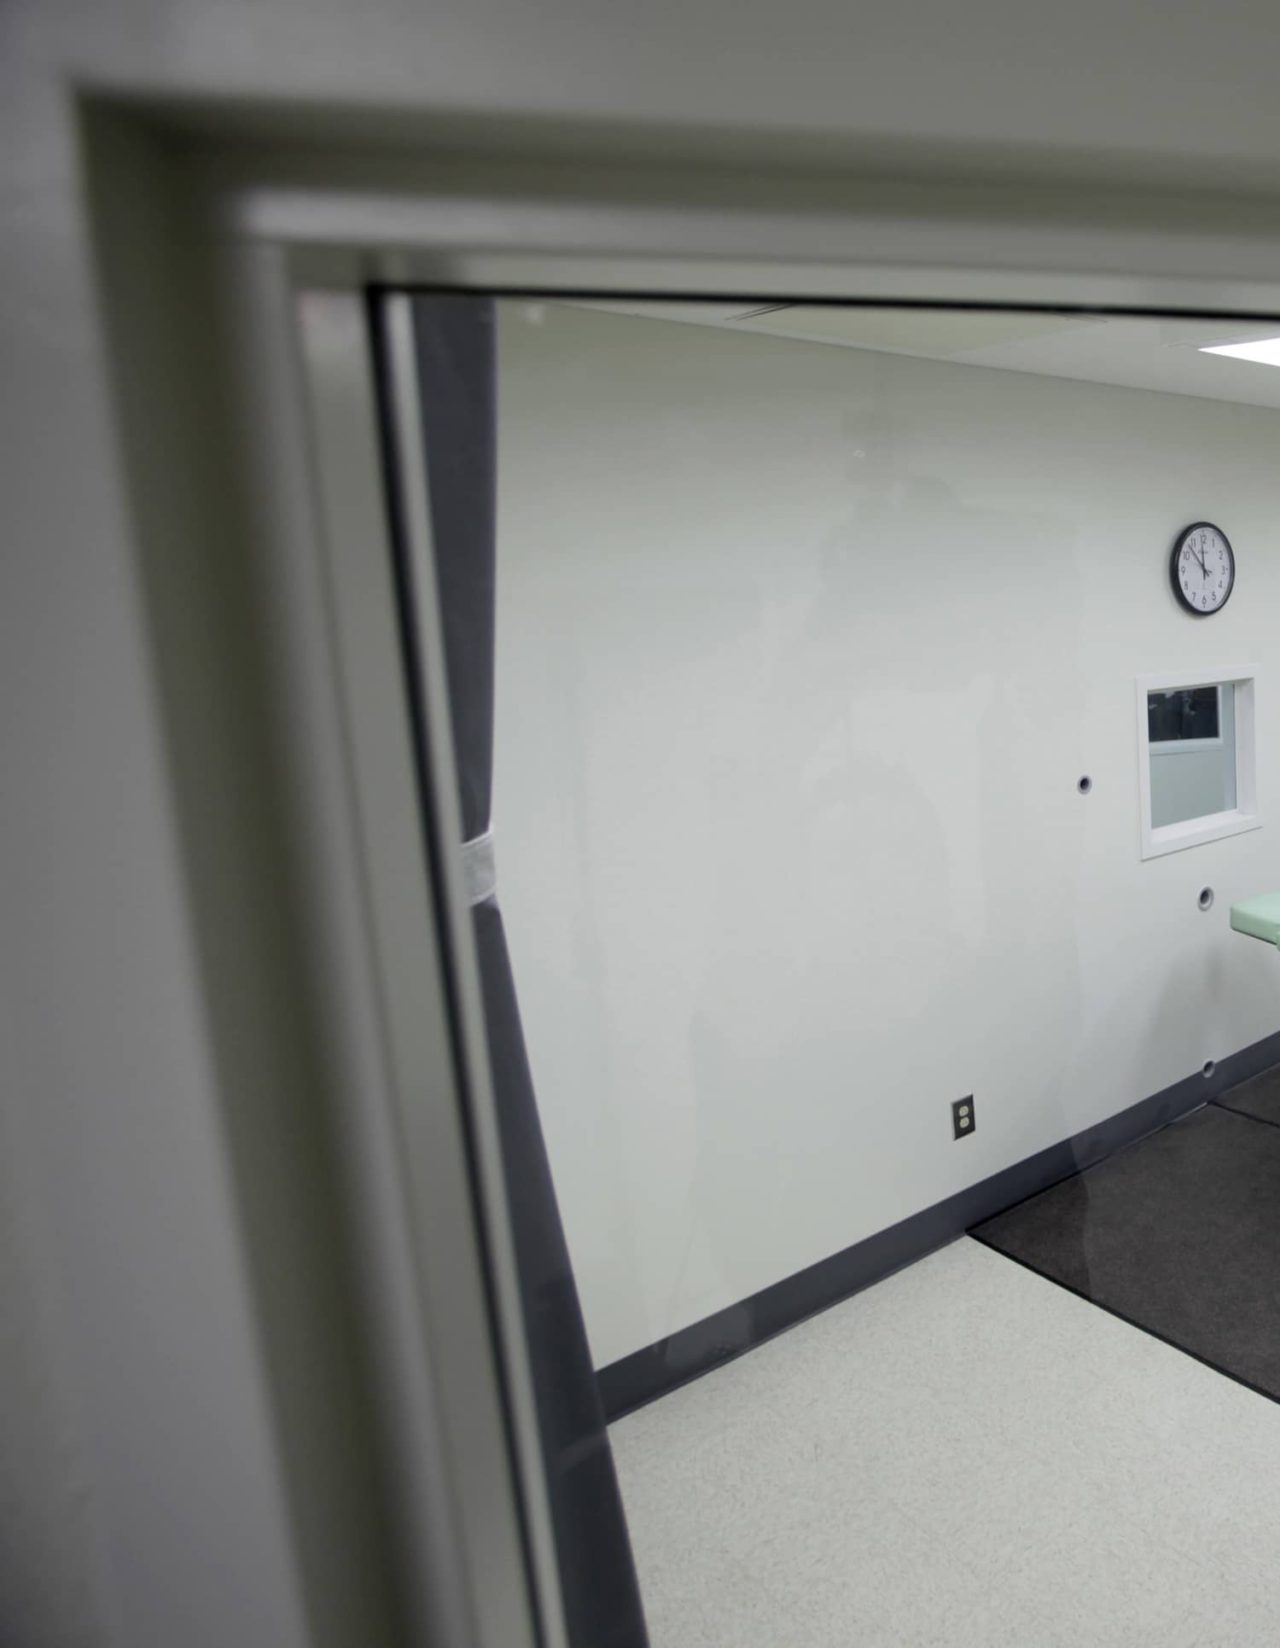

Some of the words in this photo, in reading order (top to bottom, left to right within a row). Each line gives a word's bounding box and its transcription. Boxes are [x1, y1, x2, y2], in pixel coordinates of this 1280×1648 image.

[1190, 537, 1196, 547] 11
[1200, 534, 1207, 544] 12
[1211, 539, 1216, 547] 1
[1182, 551, 1190, 560] 10
[1218, 550, 1223, 560] 2
[1180, 566, 1186, 575] 9
[1221, 566, 1226, 575] 3
[1183, 581, 1188, 590] 8
[1217, 580, 1222, 588] 4
[1191, 592, 1197, 601] 7
[1201, 595, 1207, 604] 6
[1211, 591, 1217, 600] 5
